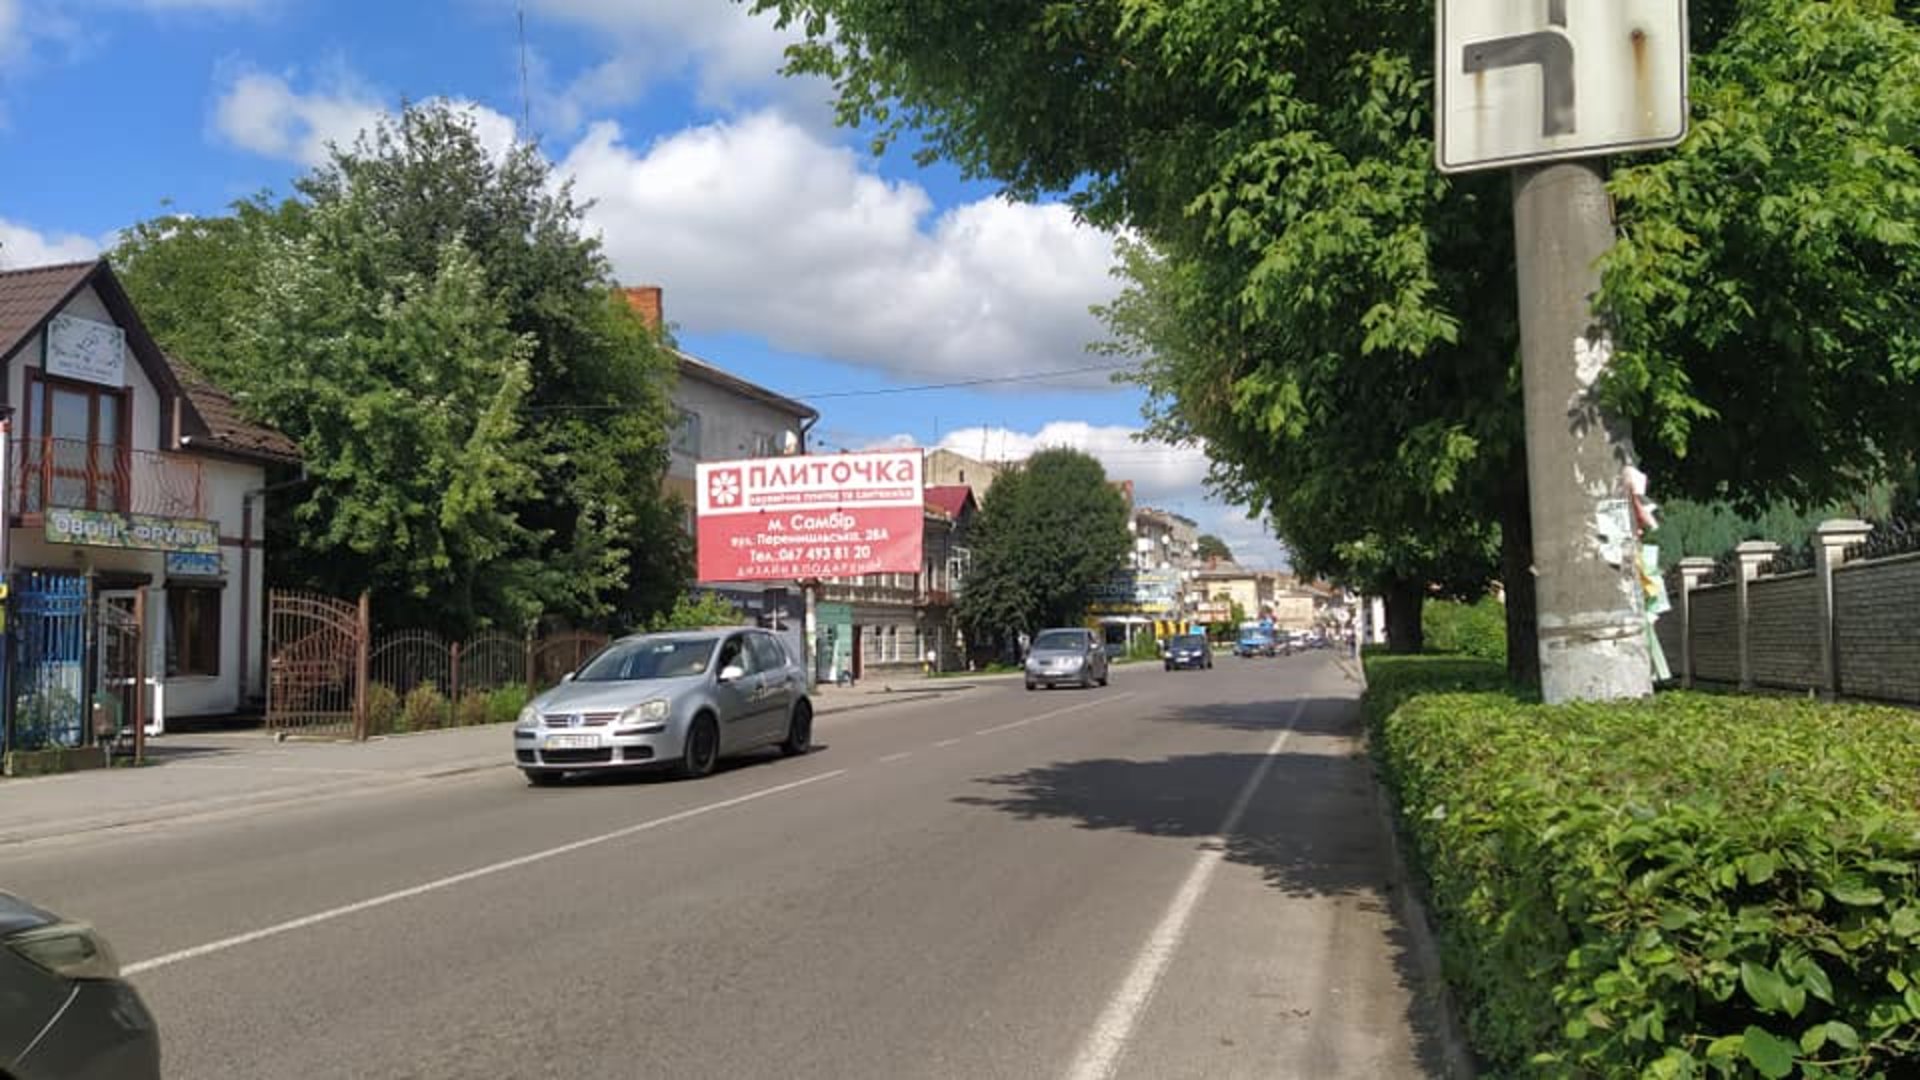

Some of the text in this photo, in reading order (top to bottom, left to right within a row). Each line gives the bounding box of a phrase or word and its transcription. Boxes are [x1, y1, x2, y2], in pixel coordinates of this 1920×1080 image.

[55, 516, 118, 538] ОВОЧІ
[133, 526, 213, 545] ФРУКТИ
[790, 513, 856, 531] Самбір
[805, 547, 831, 560] 493
[833, 547, 849, 560] 81
[853, 545, 871, 559] 20
